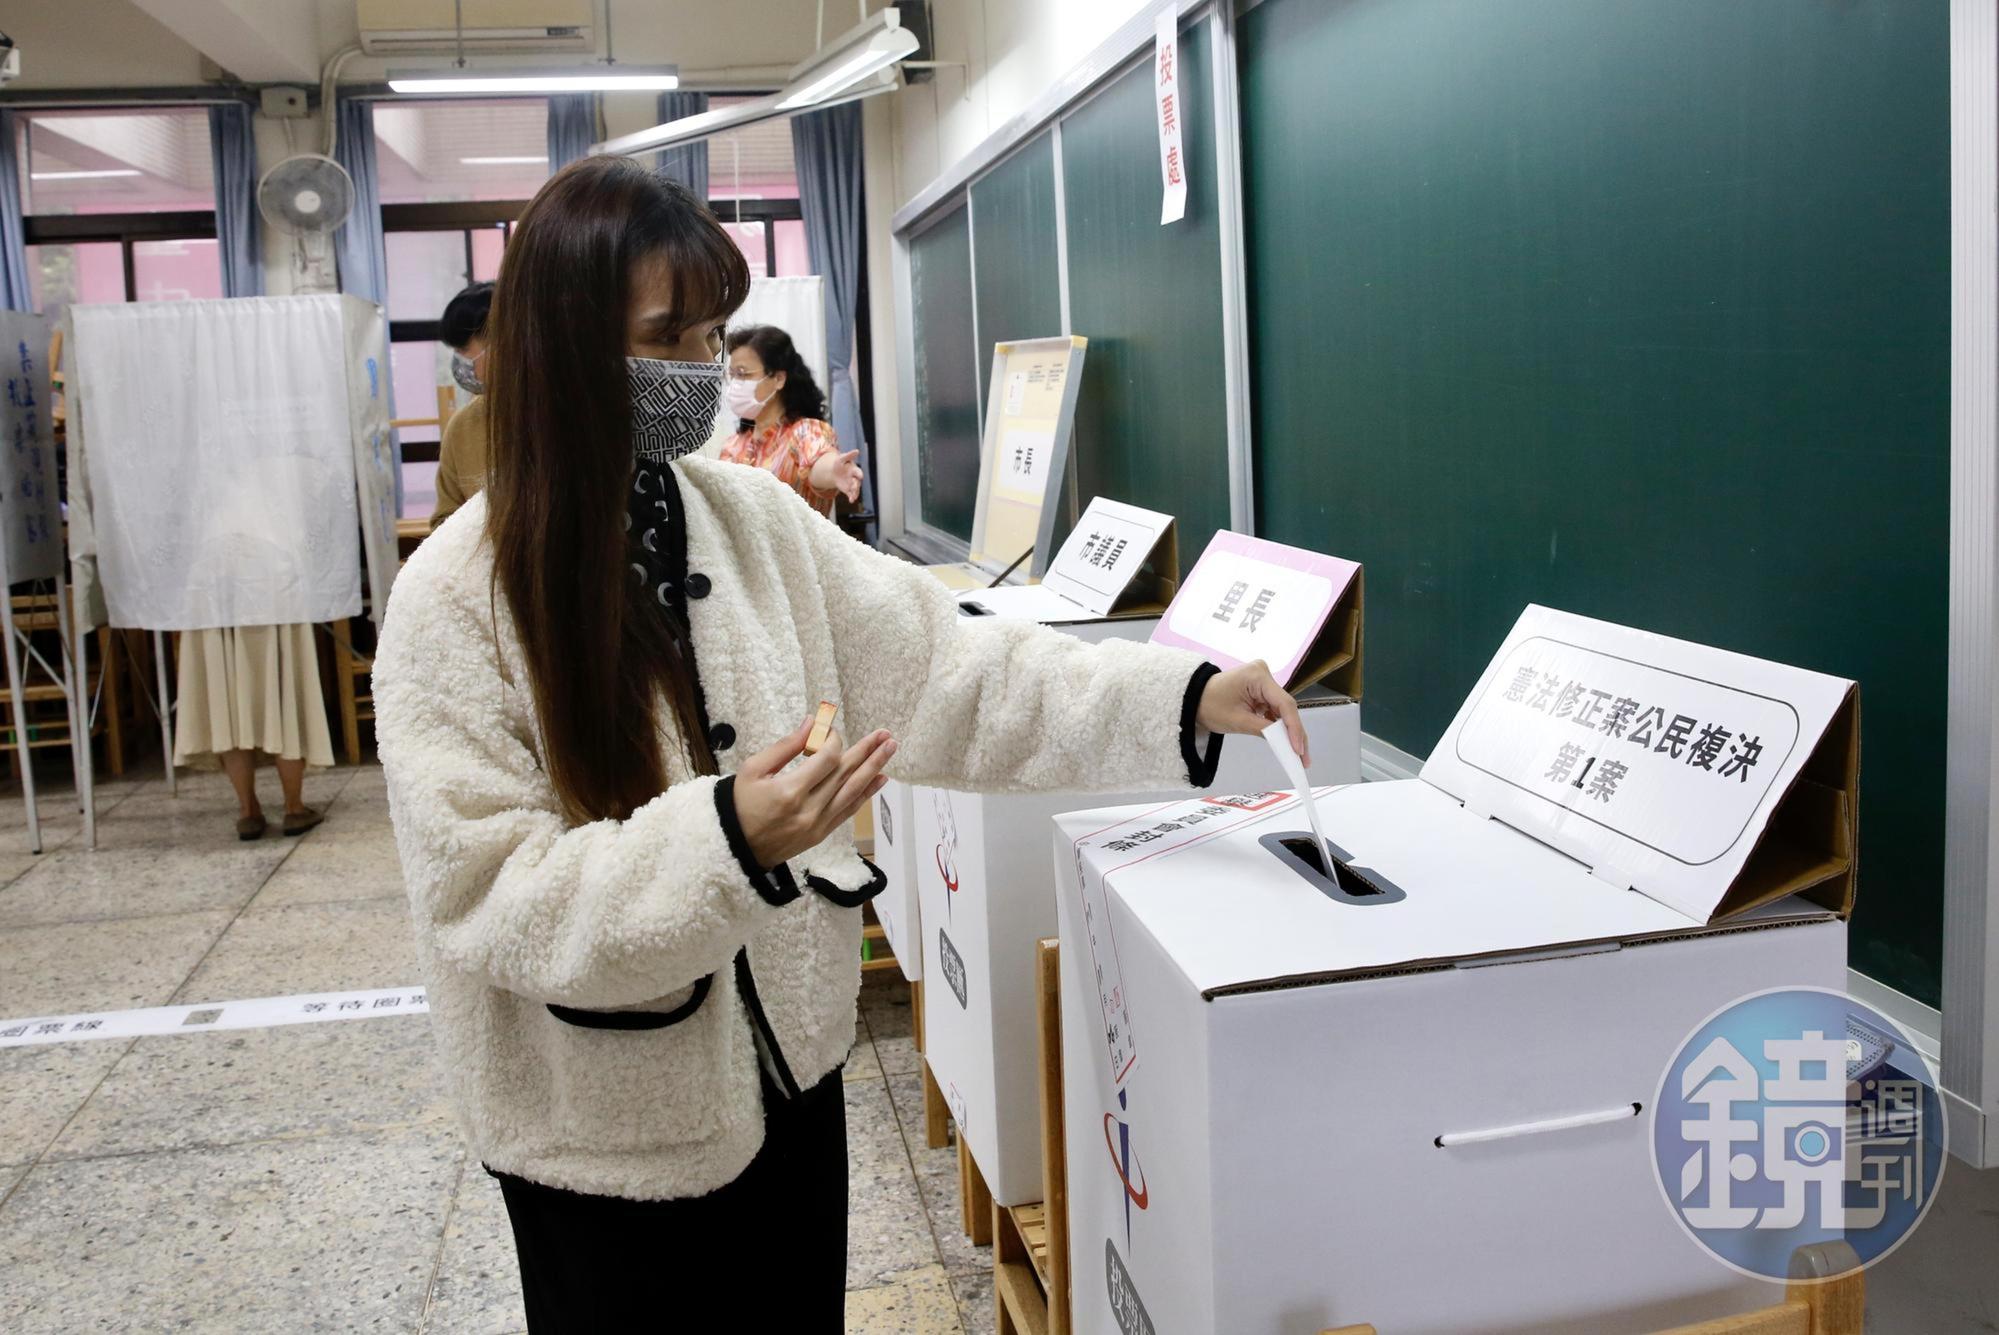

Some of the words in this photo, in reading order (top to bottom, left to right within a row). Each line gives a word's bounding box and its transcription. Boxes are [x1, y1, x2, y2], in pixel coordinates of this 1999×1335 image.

[1013, 446, 1034, 475] 市長
[1079, 531, 1128, 571] 市議員
[1212, 581, 1276, 633] 里長
[1501, 666, 1763, 783] 憲法修正案公民複決
[1543, 741, 1630, 803] 第1案
